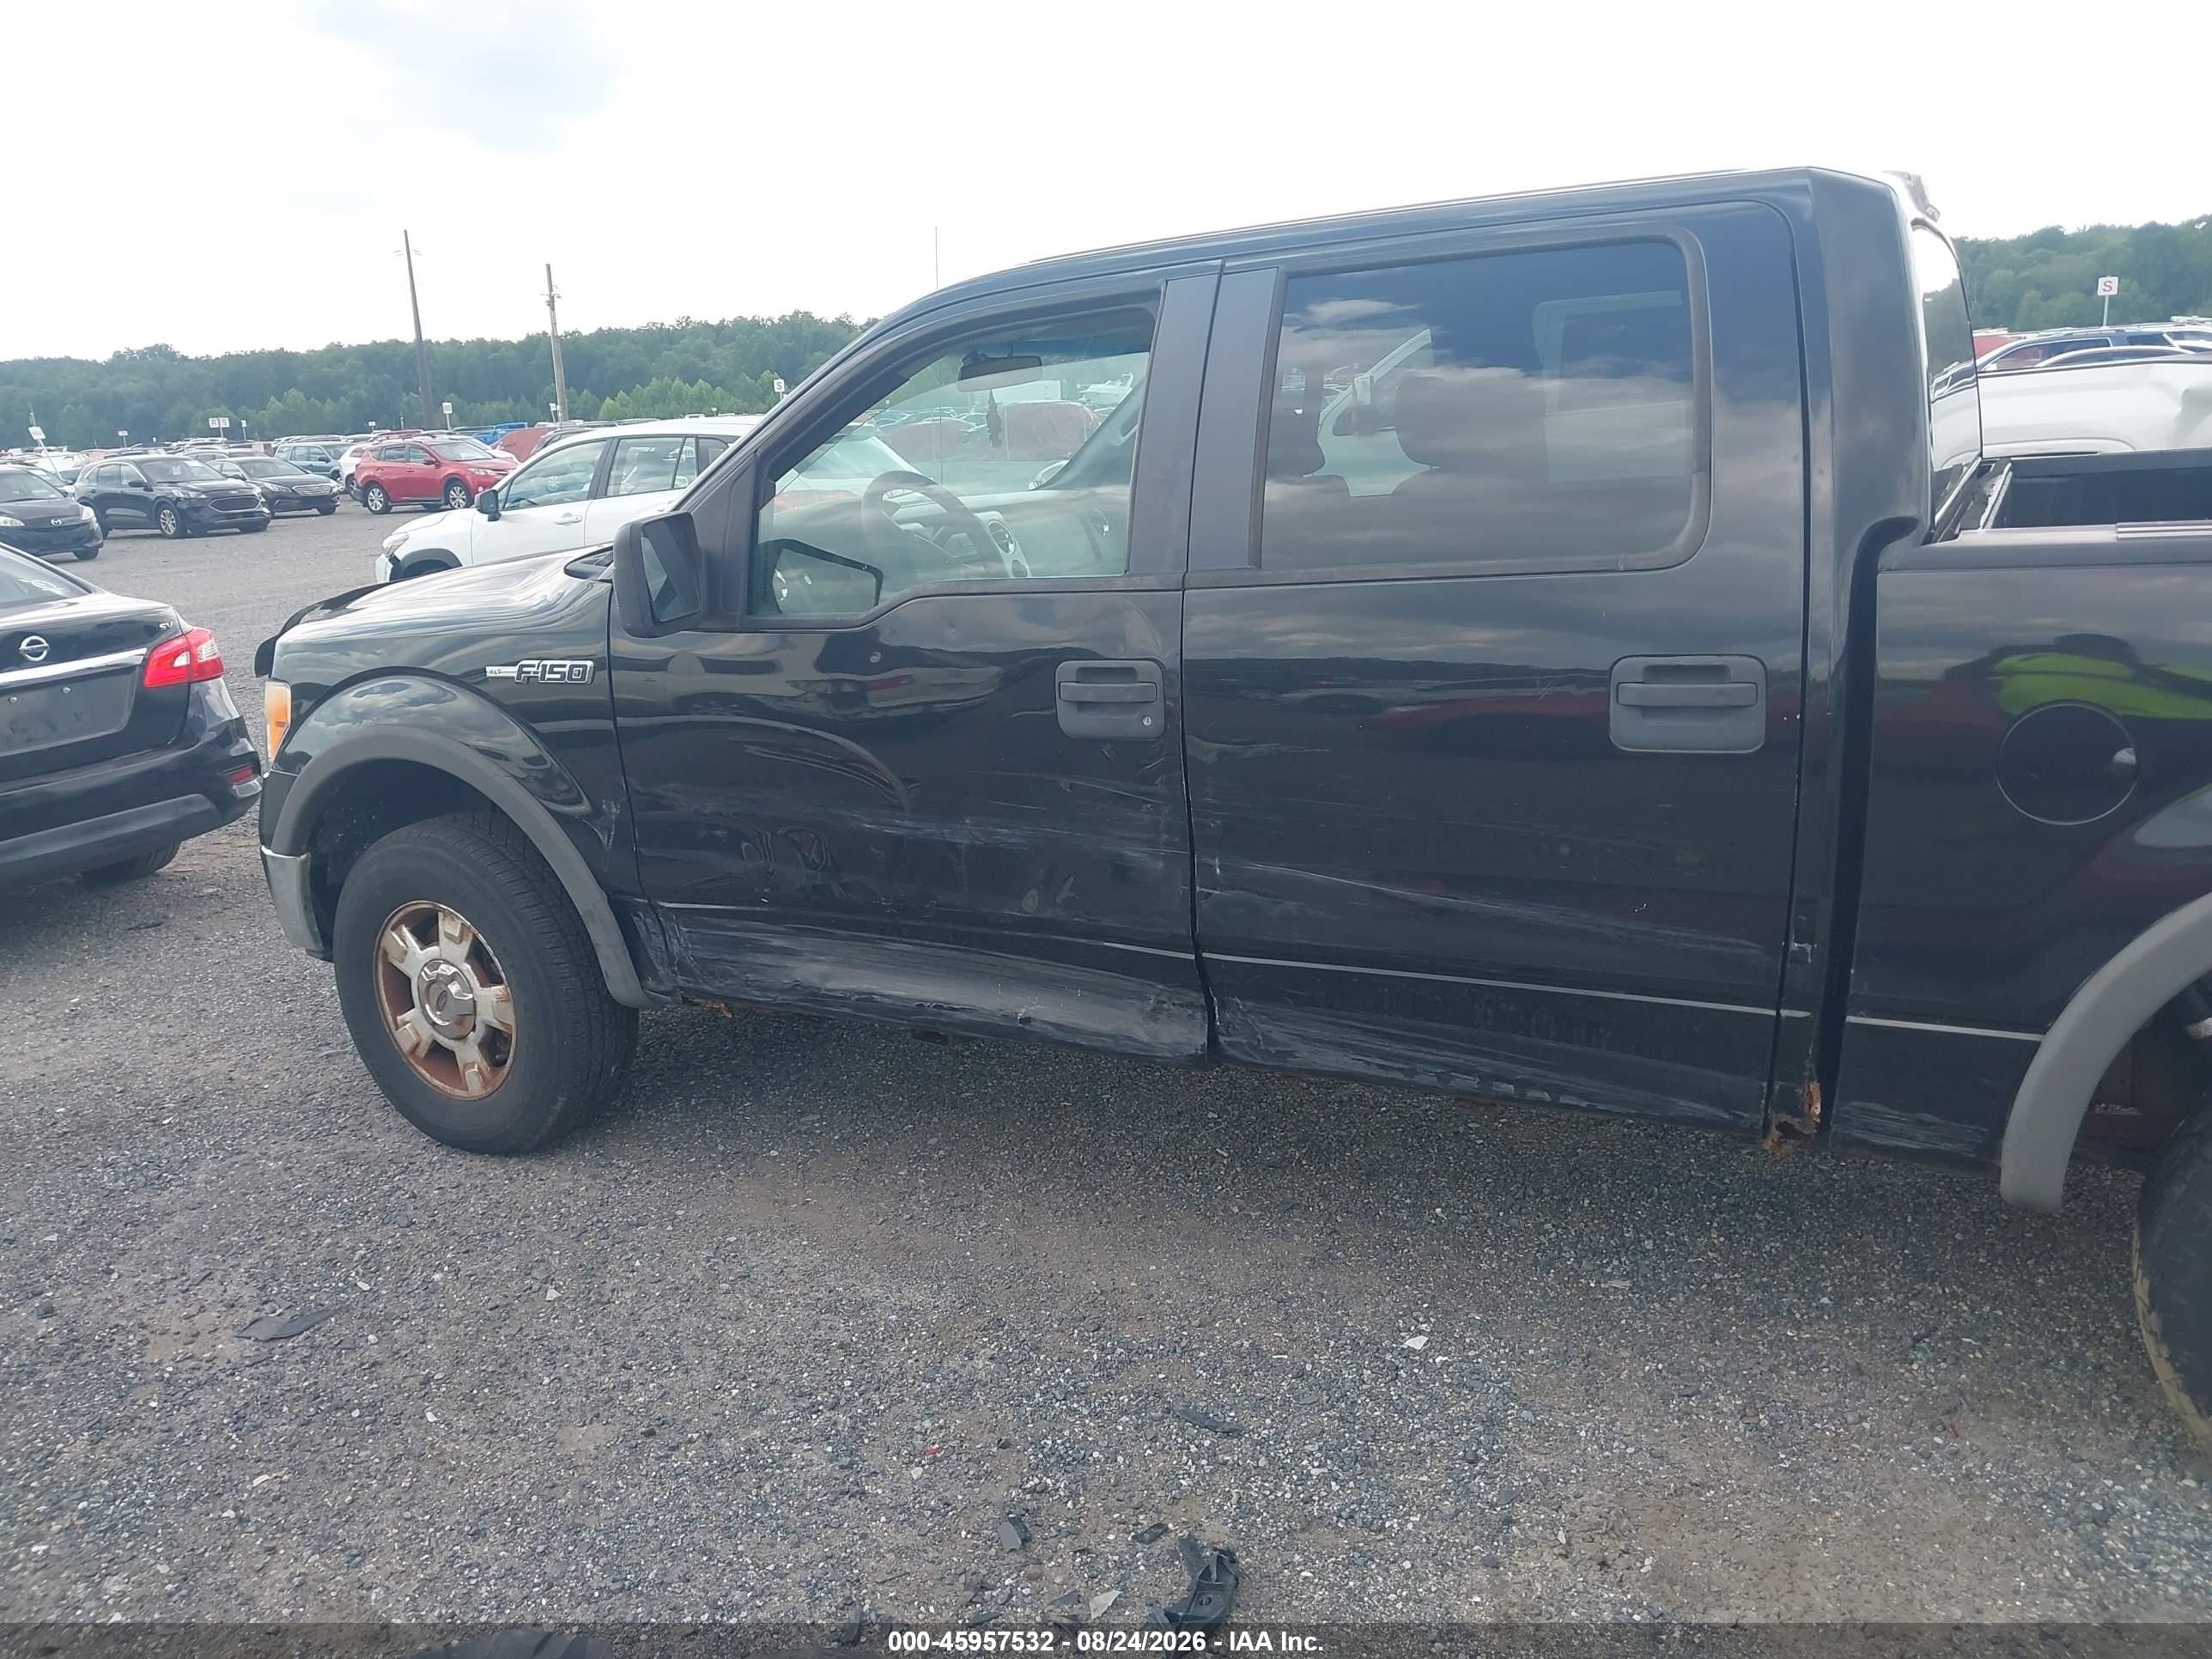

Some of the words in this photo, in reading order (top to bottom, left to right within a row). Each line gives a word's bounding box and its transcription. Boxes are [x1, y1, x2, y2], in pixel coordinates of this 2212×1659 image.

[2102, 280, 2112, 292] S
[776, 381, 782, 390] S
[159, 621, 173, 630] SV
[515, 659, 594, 684] F-150
